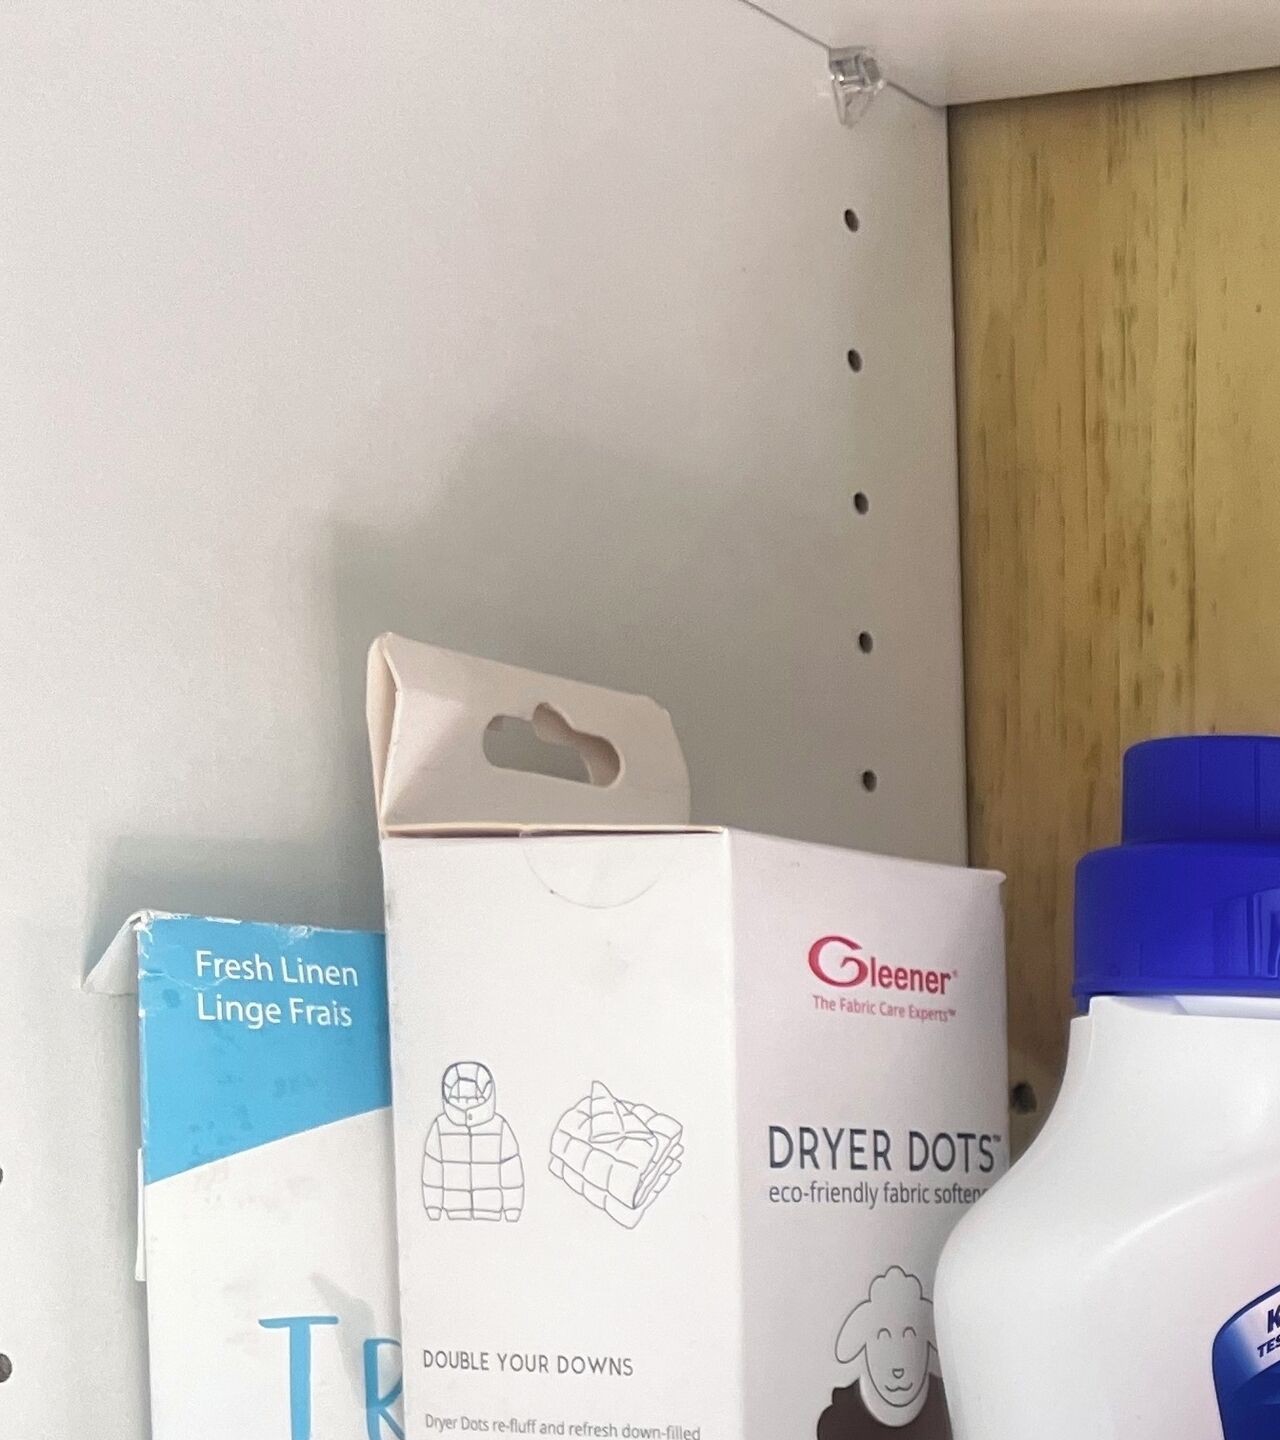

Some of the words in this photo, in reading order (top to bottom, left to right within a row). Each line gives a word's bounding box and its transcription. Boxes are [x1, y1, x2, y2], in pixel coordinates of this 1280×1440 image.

[194, 950, 274, 983] Fresh
[280, 960, 359, 987] Linen
[807, 935, 952, 995] Gleener
[197, 993, 282, 1030] Linge
[288, 999, 353, 1027] Frais
[812, 995, 836, 1012] The
[839, 998, 877, 1015] Fabric
[879, 1002, 905, 1019] Care
[768, 1125, 893, 1171] DRYER
[768, 1180, 879, 1210] eco-friendly
[883, 1181, 930, 1204] fabric
[933, 1184, 988, 1205] soften
[423, 1349, 490, 1371] DOUBLE
[497, 1353, 550, 1373] YOUR
[557, 1355, 635, 1376] DOWNS
[424, 1413, 458, 1433] Dryer
[461, 1416, 490, 1432] Dots
[492, 1418, 537, 1435] re-fluff
[539, 1420, 566, 1436] and
[568, 1422, 618, 1439] refresh
